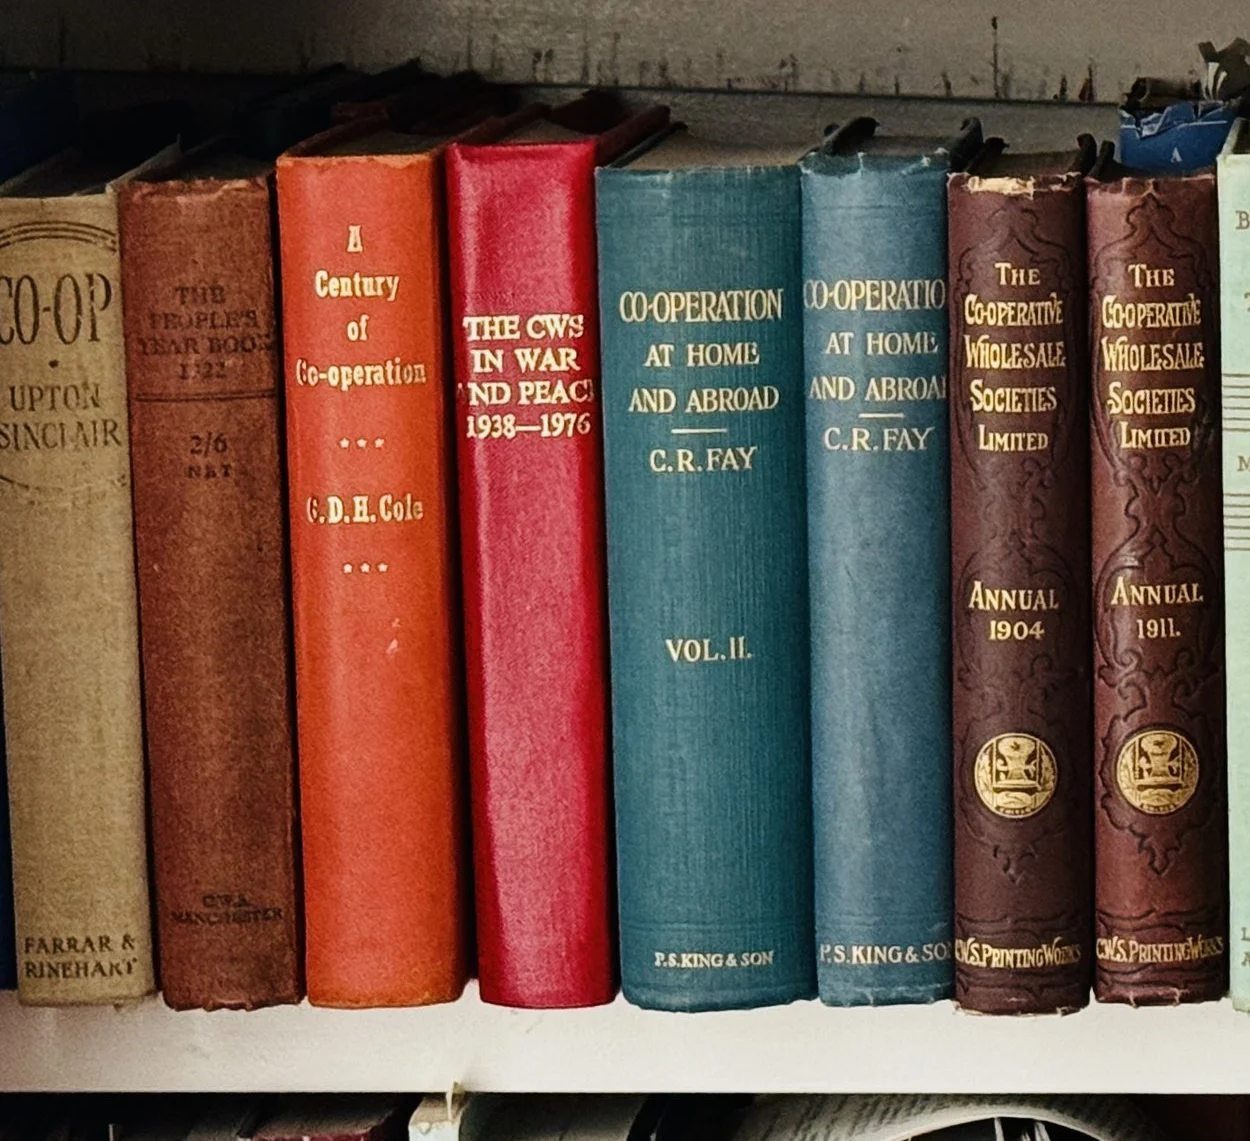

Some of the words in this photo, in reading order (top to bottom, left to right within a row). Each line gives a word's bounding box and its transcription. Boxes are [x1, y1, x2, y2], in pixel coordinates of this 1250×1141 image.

[347, 225, 364, 252] A
[315, 269, 400, 302] Century
[619, 288, 785, 323] CO-OPERATION
[347, 315, 370, 341] of
[463, 315, 520, 341] THE
[526, 314, 584, 340] CWS
[643, 344, 674, 367] AT
[687, 342, 760, 367] HOME
[825, 333, 853, 355] AT
[866, 332, 938, 355] HOME
[471, 349, 504, 373] IN
[514, 347, 581, 372] WAR
[296, 358, 427, 391] Co-operation
[9, 384, 100, 412] UPTON
[628, 388, 676, 413] AND
[685, 386, 780, 413] ABROAD
[809, 377, 855, 401] AND
[0, 419, 121, 452] SINCLAIR
[989, 620, 1045, 641] 1904
[1136, 618, 1182, 640] 1911.
[24, 935, 110, 955] FARRAR
[25, 959, 137, 979] RINEHART
